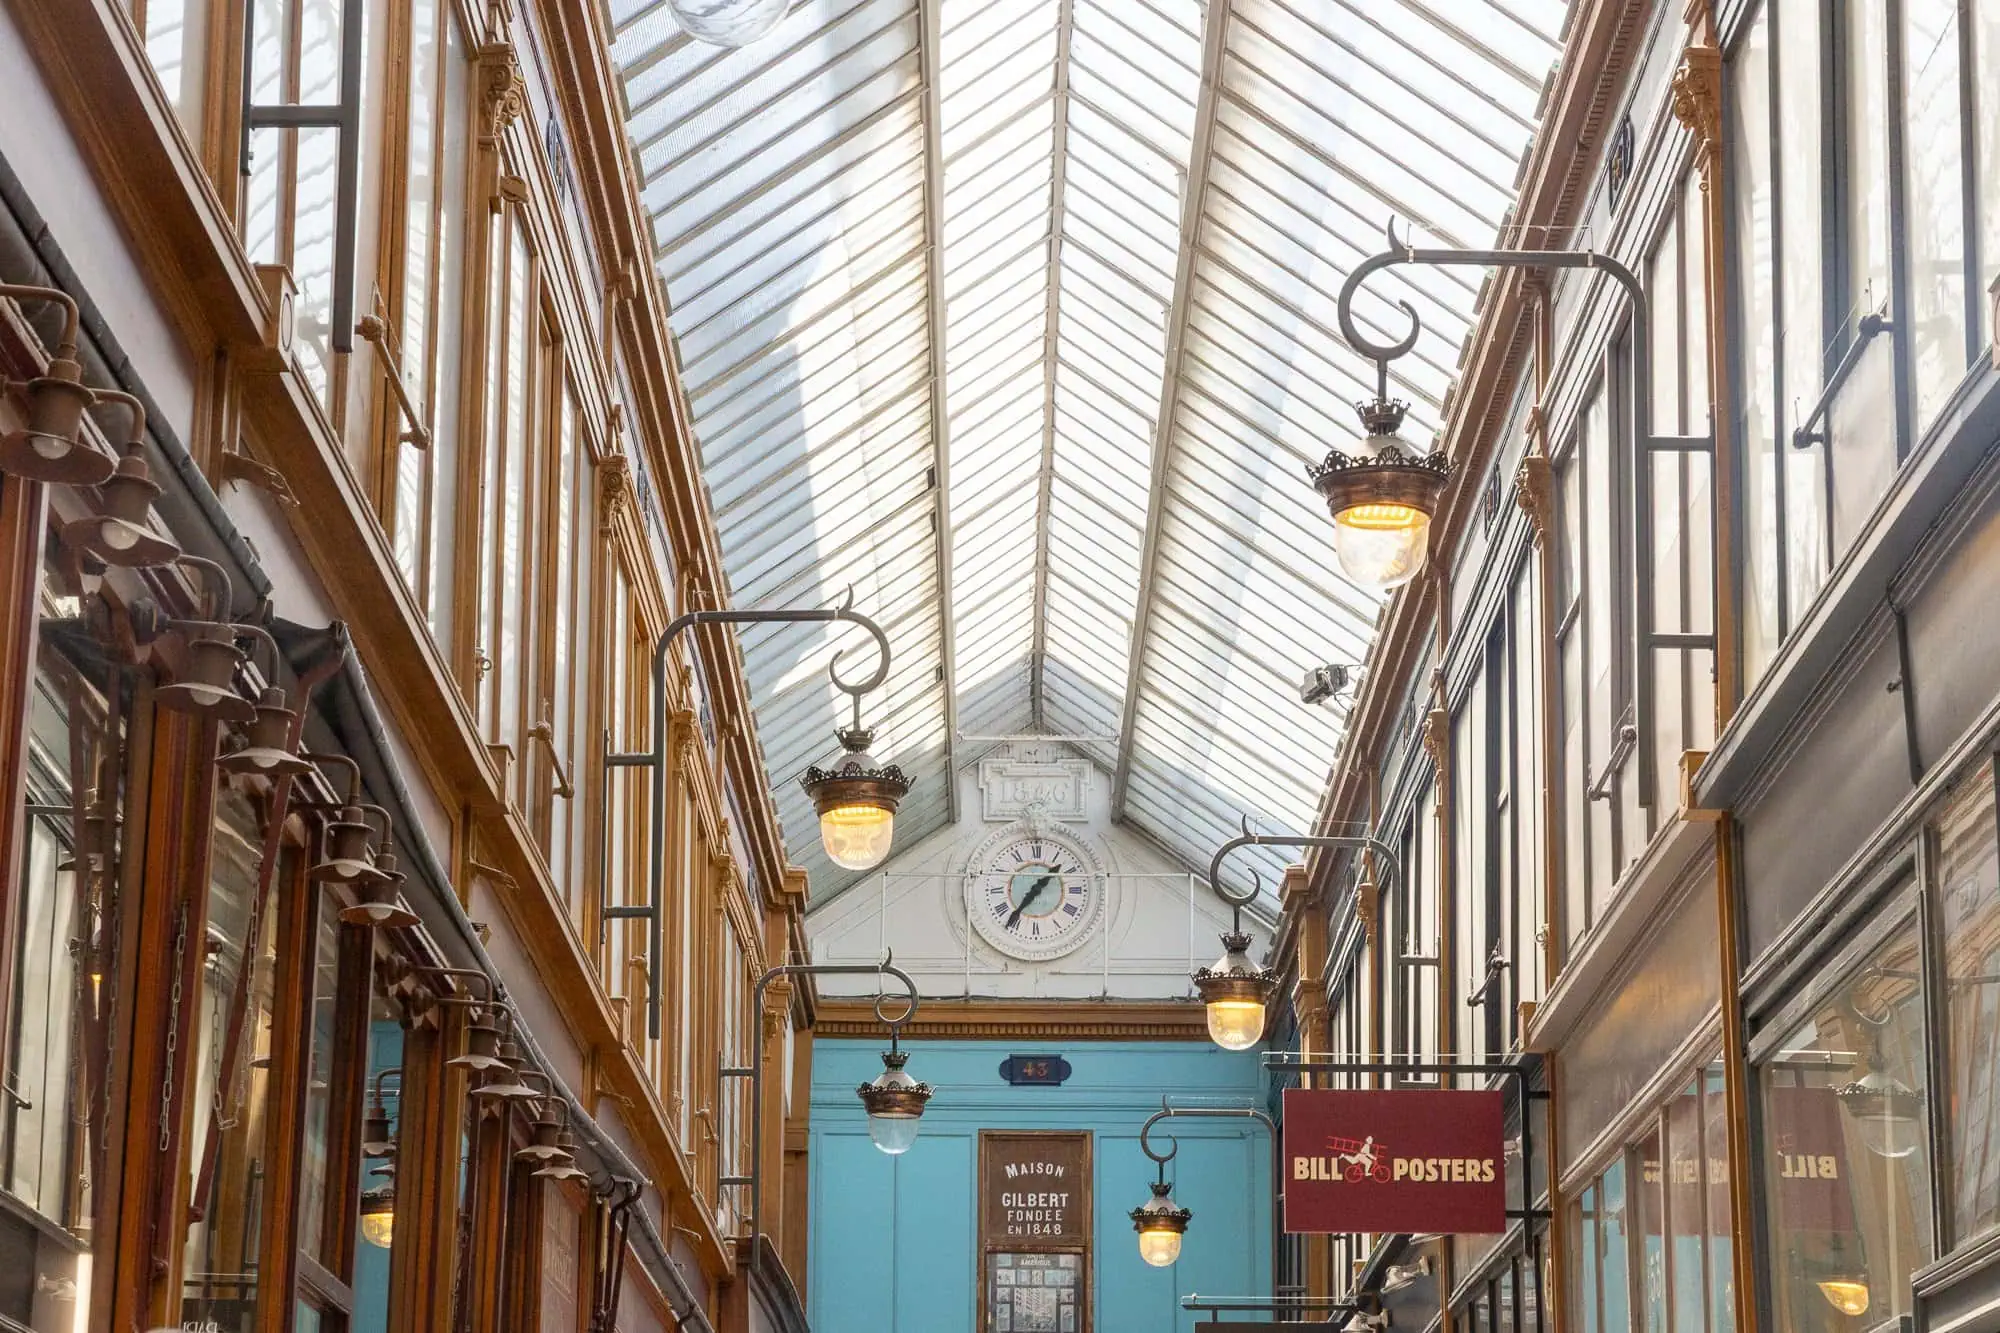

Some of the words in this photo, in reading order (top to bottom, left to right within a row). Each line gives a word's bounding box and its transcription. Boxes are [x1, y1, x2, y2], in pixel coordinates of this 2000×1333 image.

[1004, 1162, 1065, 1179] MAISON
[1293, 1156, 1344, 1181] BILL
[1393, 1158, 1496, 1183] POSTERS
[1001, 1193, 1069, 1208] GILBERT
[1007, 1225, 1022, 1235] EN
[1026, 1223, 1063, 1235] 1848
